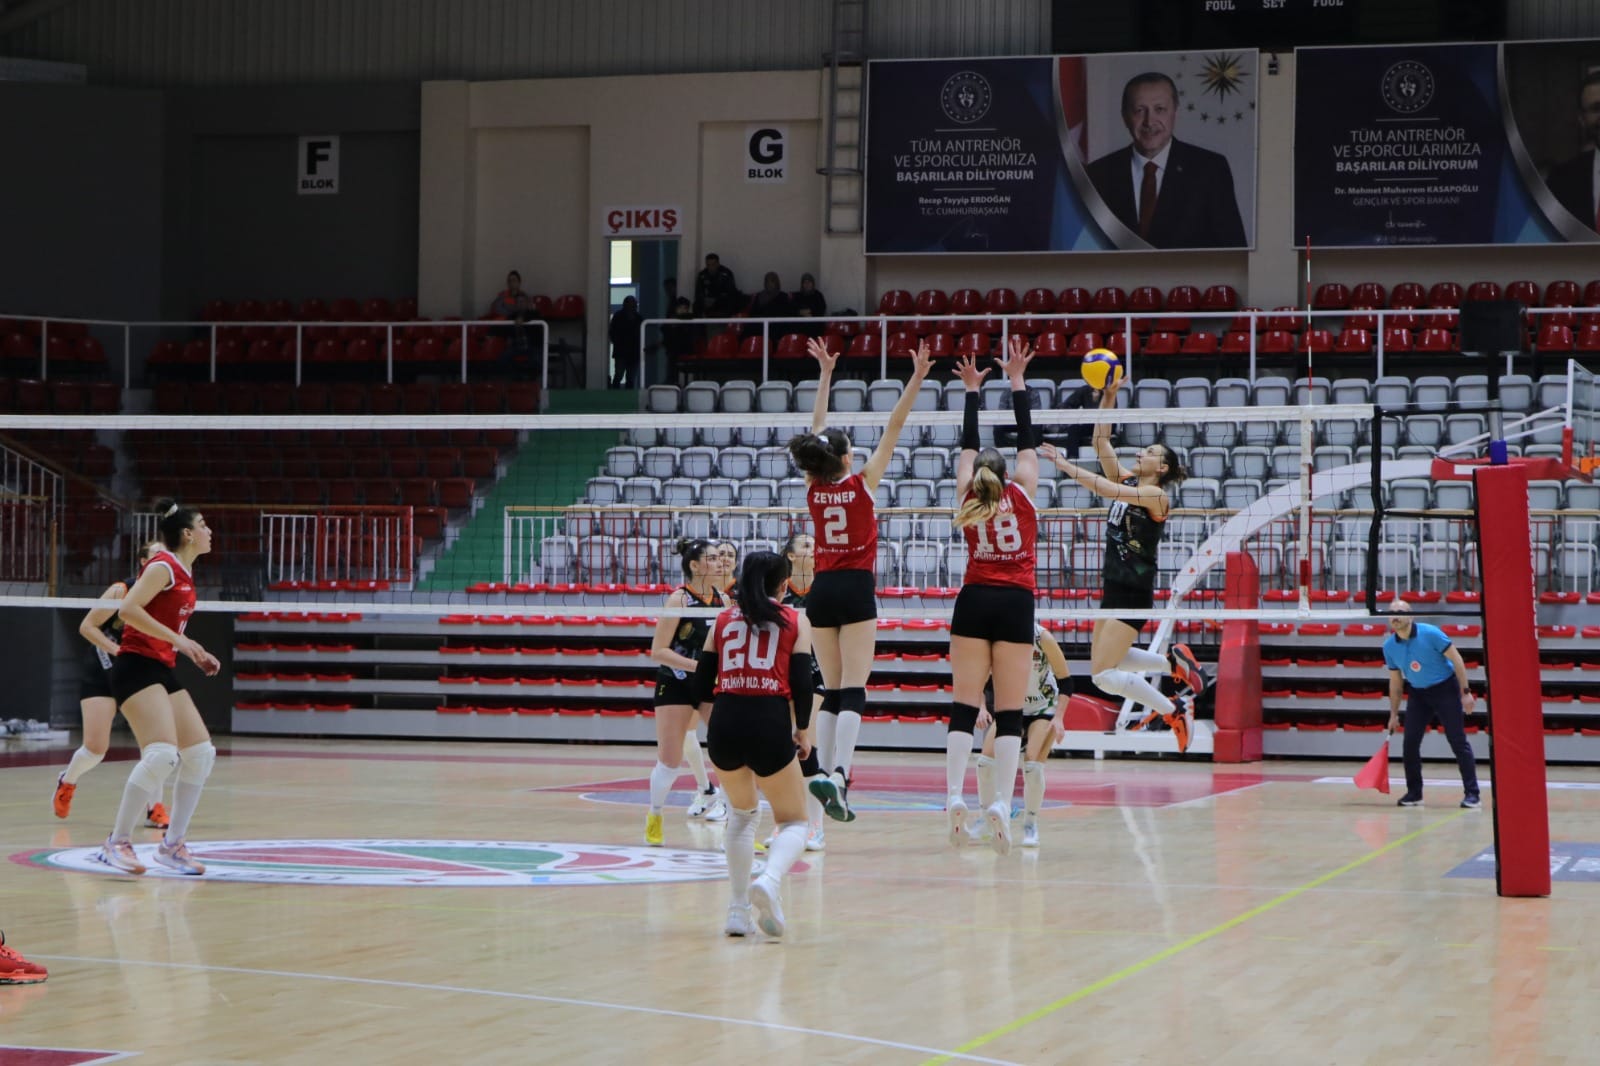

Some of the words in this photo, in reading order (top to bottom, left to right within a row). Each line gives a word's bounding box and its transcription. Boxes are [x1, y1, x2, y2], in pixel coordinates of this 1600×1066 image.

[1205, 0, 1236, 11] FOUL
[1263, 0, 1287, 8] SET
[1349, 128, 1383, 142] TÜM
[1385, 126, 1466, 141] ANTRENÖR
[748, 128, 784, 165] G
[910, 138, 942, 153] TÜM
[944, 136, 1022, 152] ANTRENÖR
[1332, 144, 1351, 158] VE
[1354, 142, 1482, 157] SPORCULARIMIZA
[306, 141, 332, 176] F
[894, 155, 911, 168] VE
[914, 152, 1037, 168] SPORCULARIMIZA
[1335, 160, 1406, 174] BAŞARILAR
[1407, 158, 1479, 171] DİLİYORUM
[748, 168, 783, 179] BLOK
[896, 171, 964, 184] BAŞARILAR
[966, 168, 1035, 181] DİLİYORUM
[301, 178, 335, 190] BLOK
[1426, 183, 1479, 193] KASAPOĞLU
[970, 194, 1011, 204] ERDOĞAN
[607, 208, 678, 234] ÇIKIŞ
[813, 490, 856, 505] ZEYNEP
[822, 505, 849, 545] 2
[973, 512, 1023, 553] 18
[720, 620, 780, 672] 20
